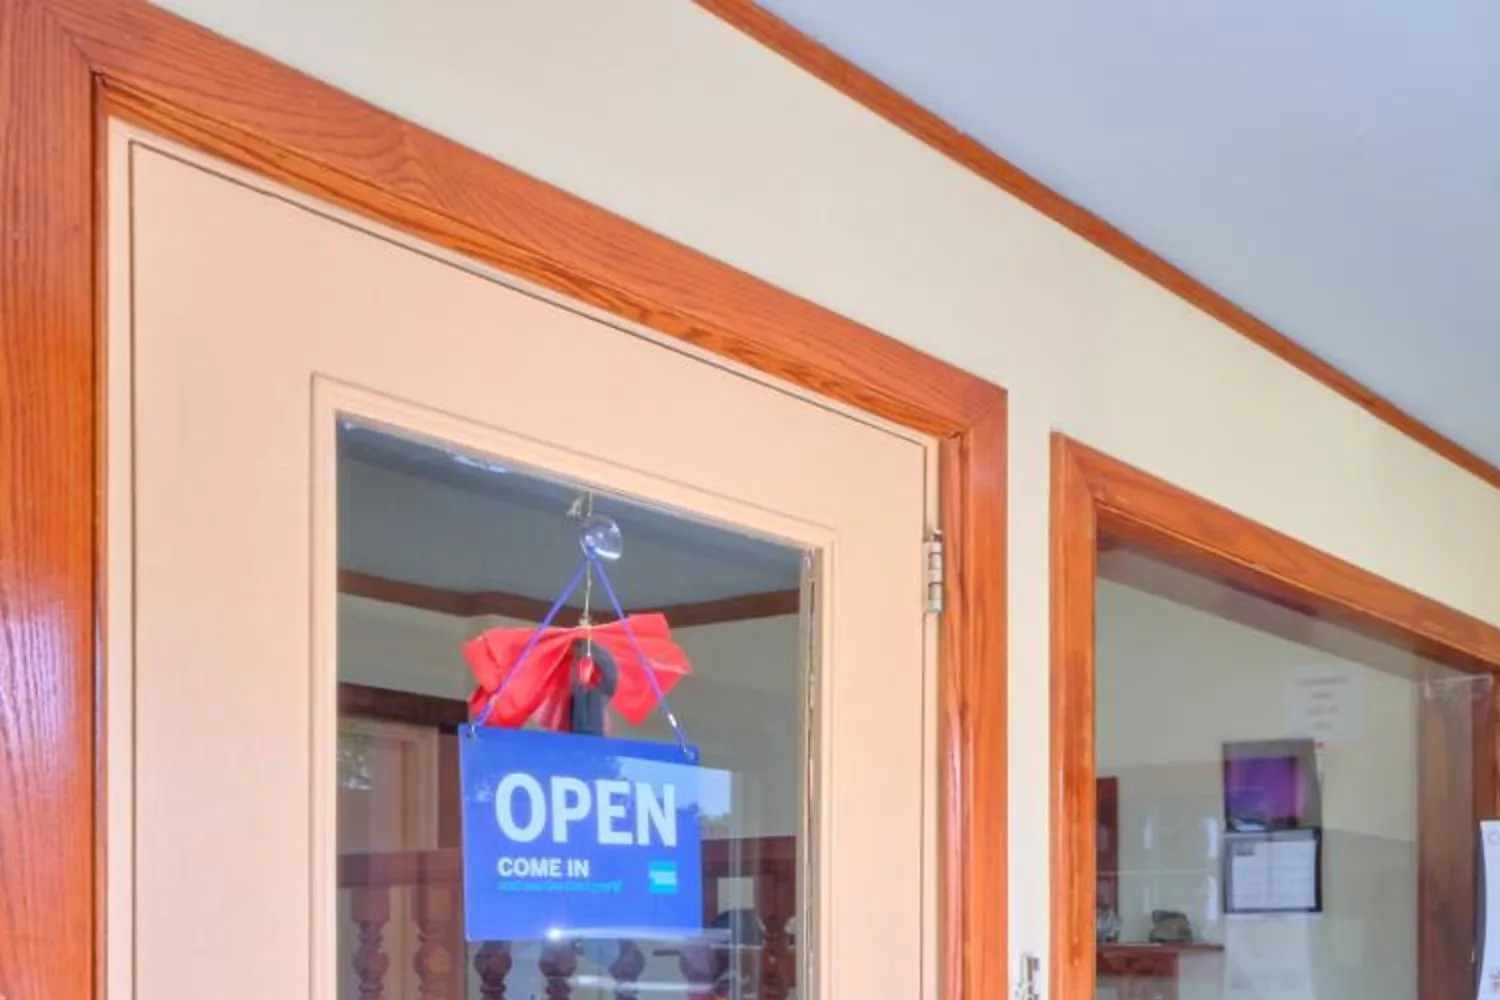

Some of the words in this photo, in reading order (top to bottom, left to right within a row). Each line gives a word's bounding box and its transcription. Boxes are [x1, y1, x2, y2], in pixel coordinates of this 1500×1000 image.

[495, 772, 677, 847] OPEN
[497, 856, 562, 877] COME
[567, 858, 590, 877] IN
